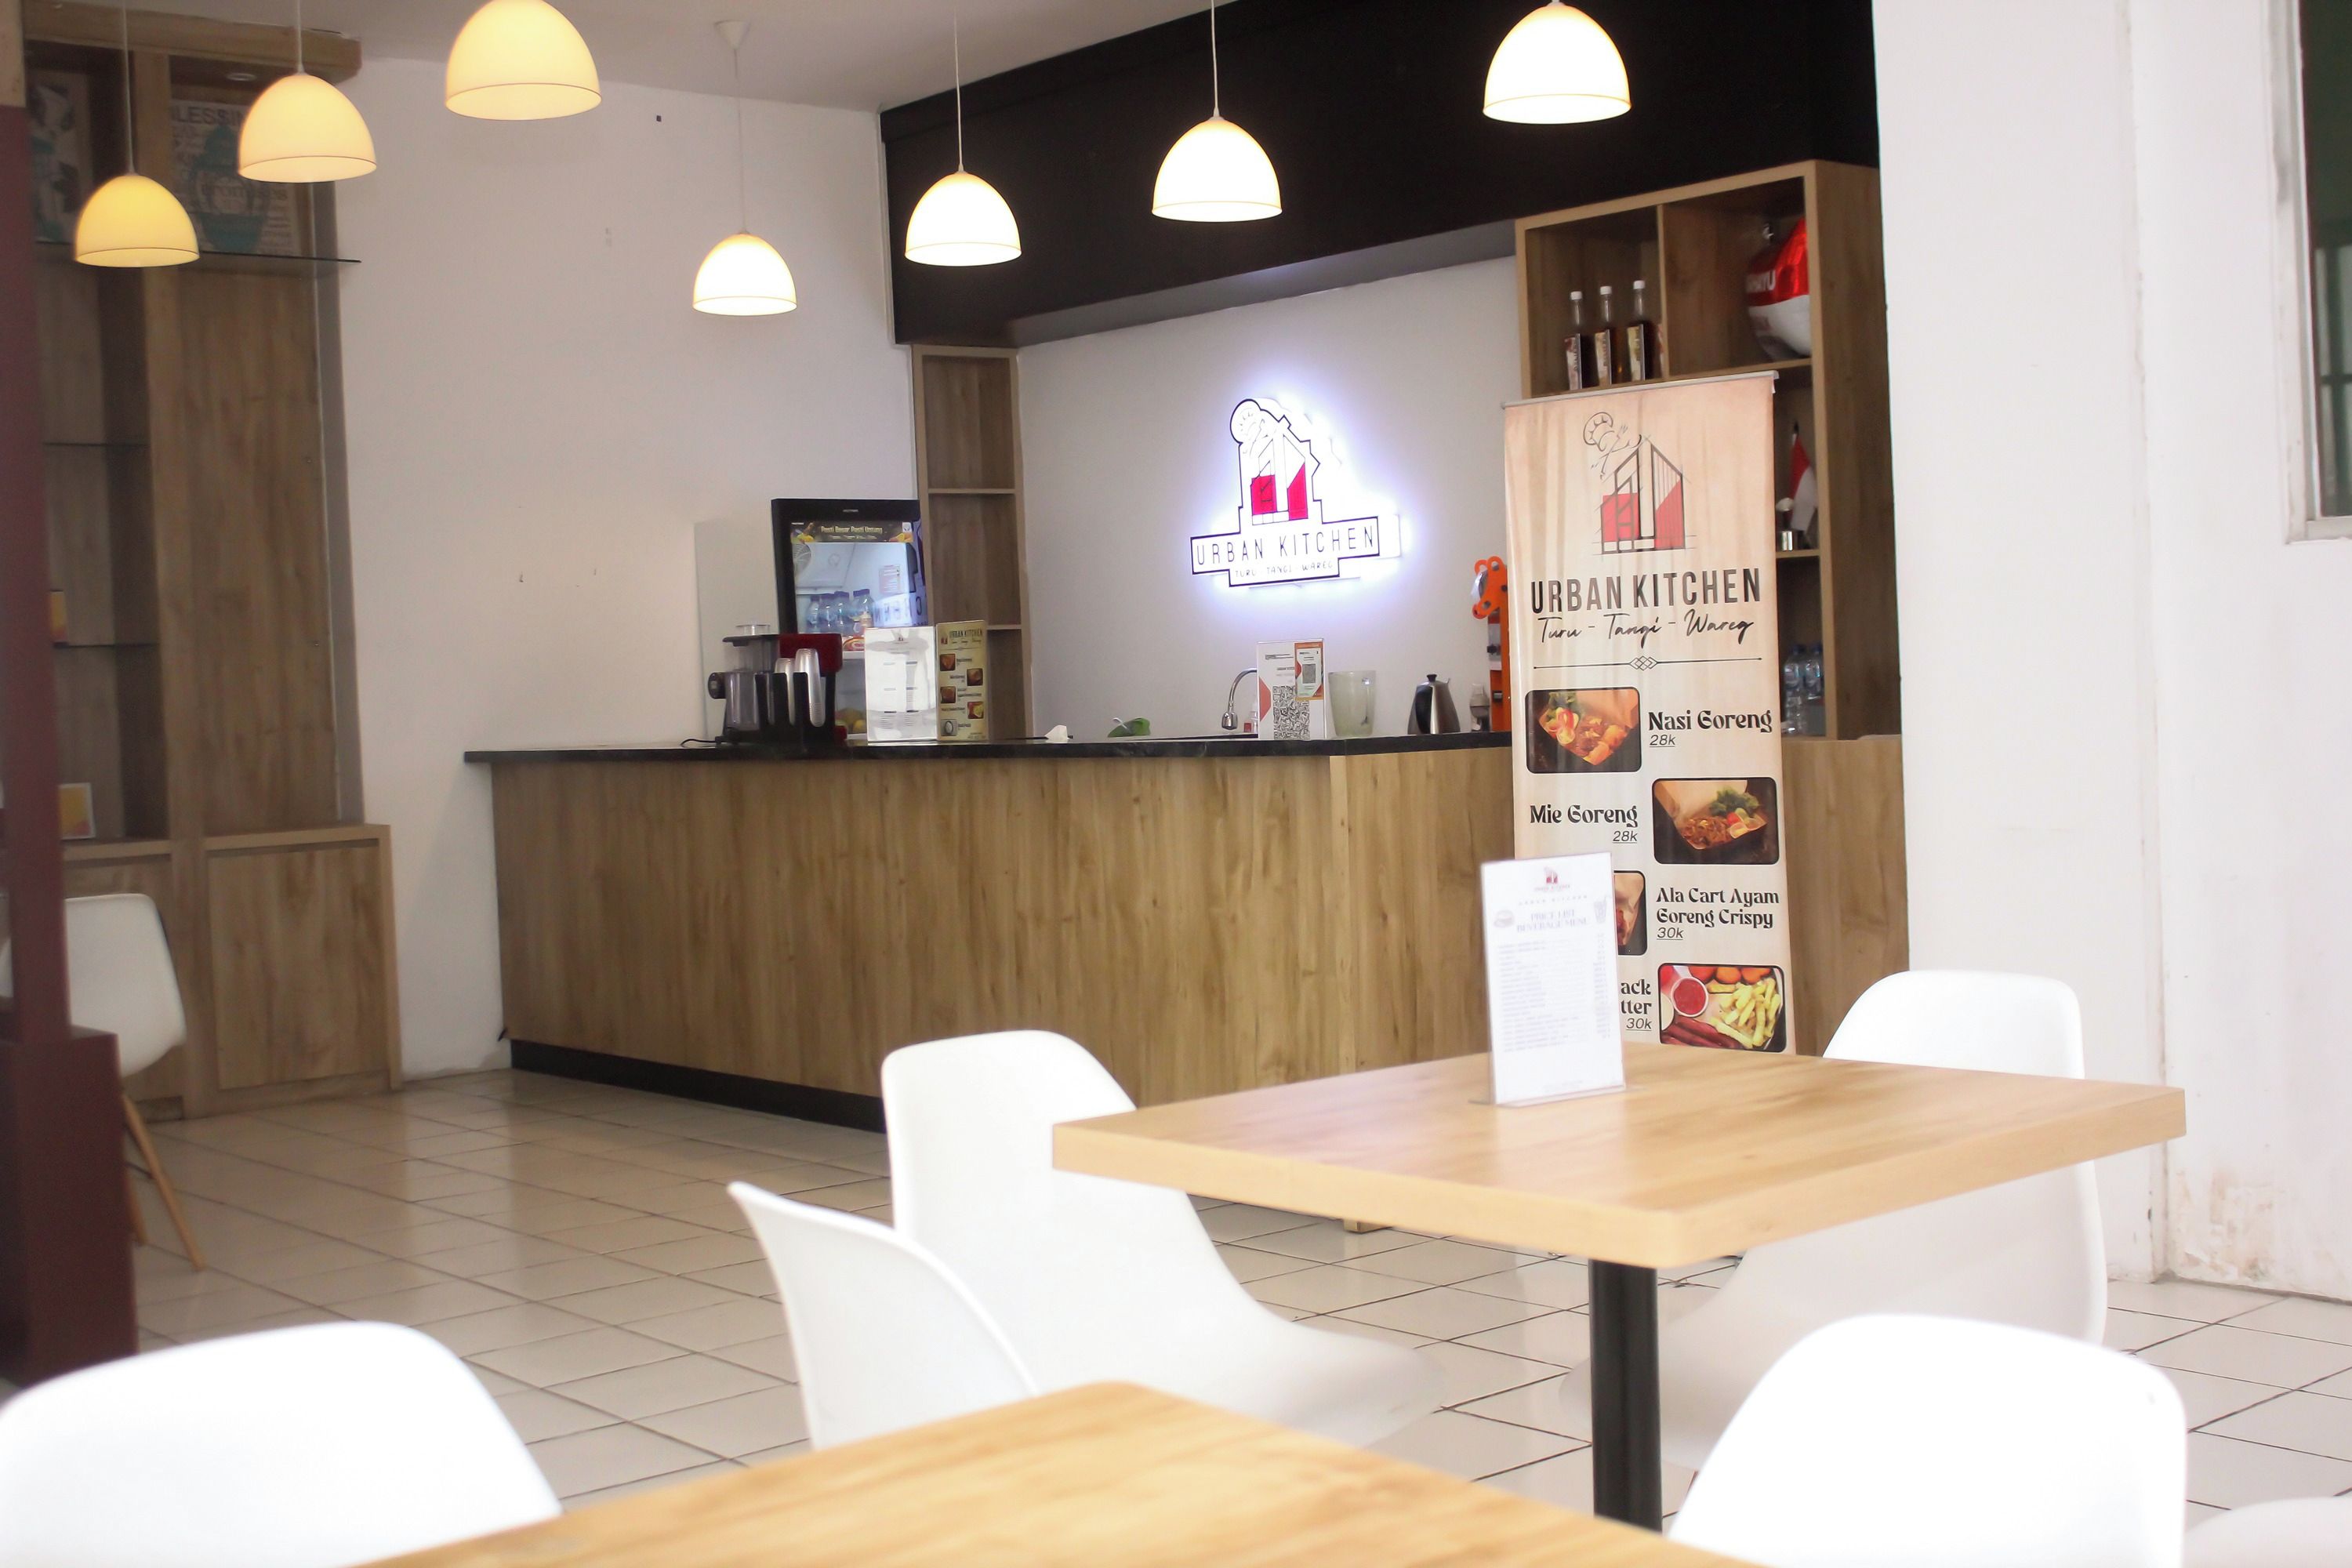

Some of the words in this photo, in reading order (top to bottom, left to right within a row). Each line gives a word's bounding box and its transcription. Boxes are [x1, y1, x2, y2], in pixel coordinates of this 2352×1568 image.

[1196, 538, 1263, 565] URBAN
[1279, 525, 1374, 557] KITCHEN
[1531, 575, 1621, 614] URBAN
[1633, 568, 1761, 608] KITCHEN
[1537, 616, 1582, 643] Turu
[1603, 612, 1663, 648] Tangi
[1684, 608, 1755, 644] Wareg
[1648, 710, 1692, 731] Nasi
[1697, 710, 1773, 733] Goreng
[1650, 734, 1675, 746] 28k
[1530, 804, 1563, 824] Mie
[1568, 804, 1639, 828] Goreng
[1613, 830, 1638, 842] 28k
[1656, 887, 1685, 902] Ala
[1688, 887, 1726, 902] Cart
[1730, 887, 1780, 907] Ayam
[1656, 908, 1715, 927] Goreng
[1719, 908, 1773, 928] Crispy
[1657, 927, 1684, 938] 30k
[1621, 978, 1651, 995] ack
[1621, 1000, 1652, 1014] tter
[1626, 1018, 1652, 1029] 30k
